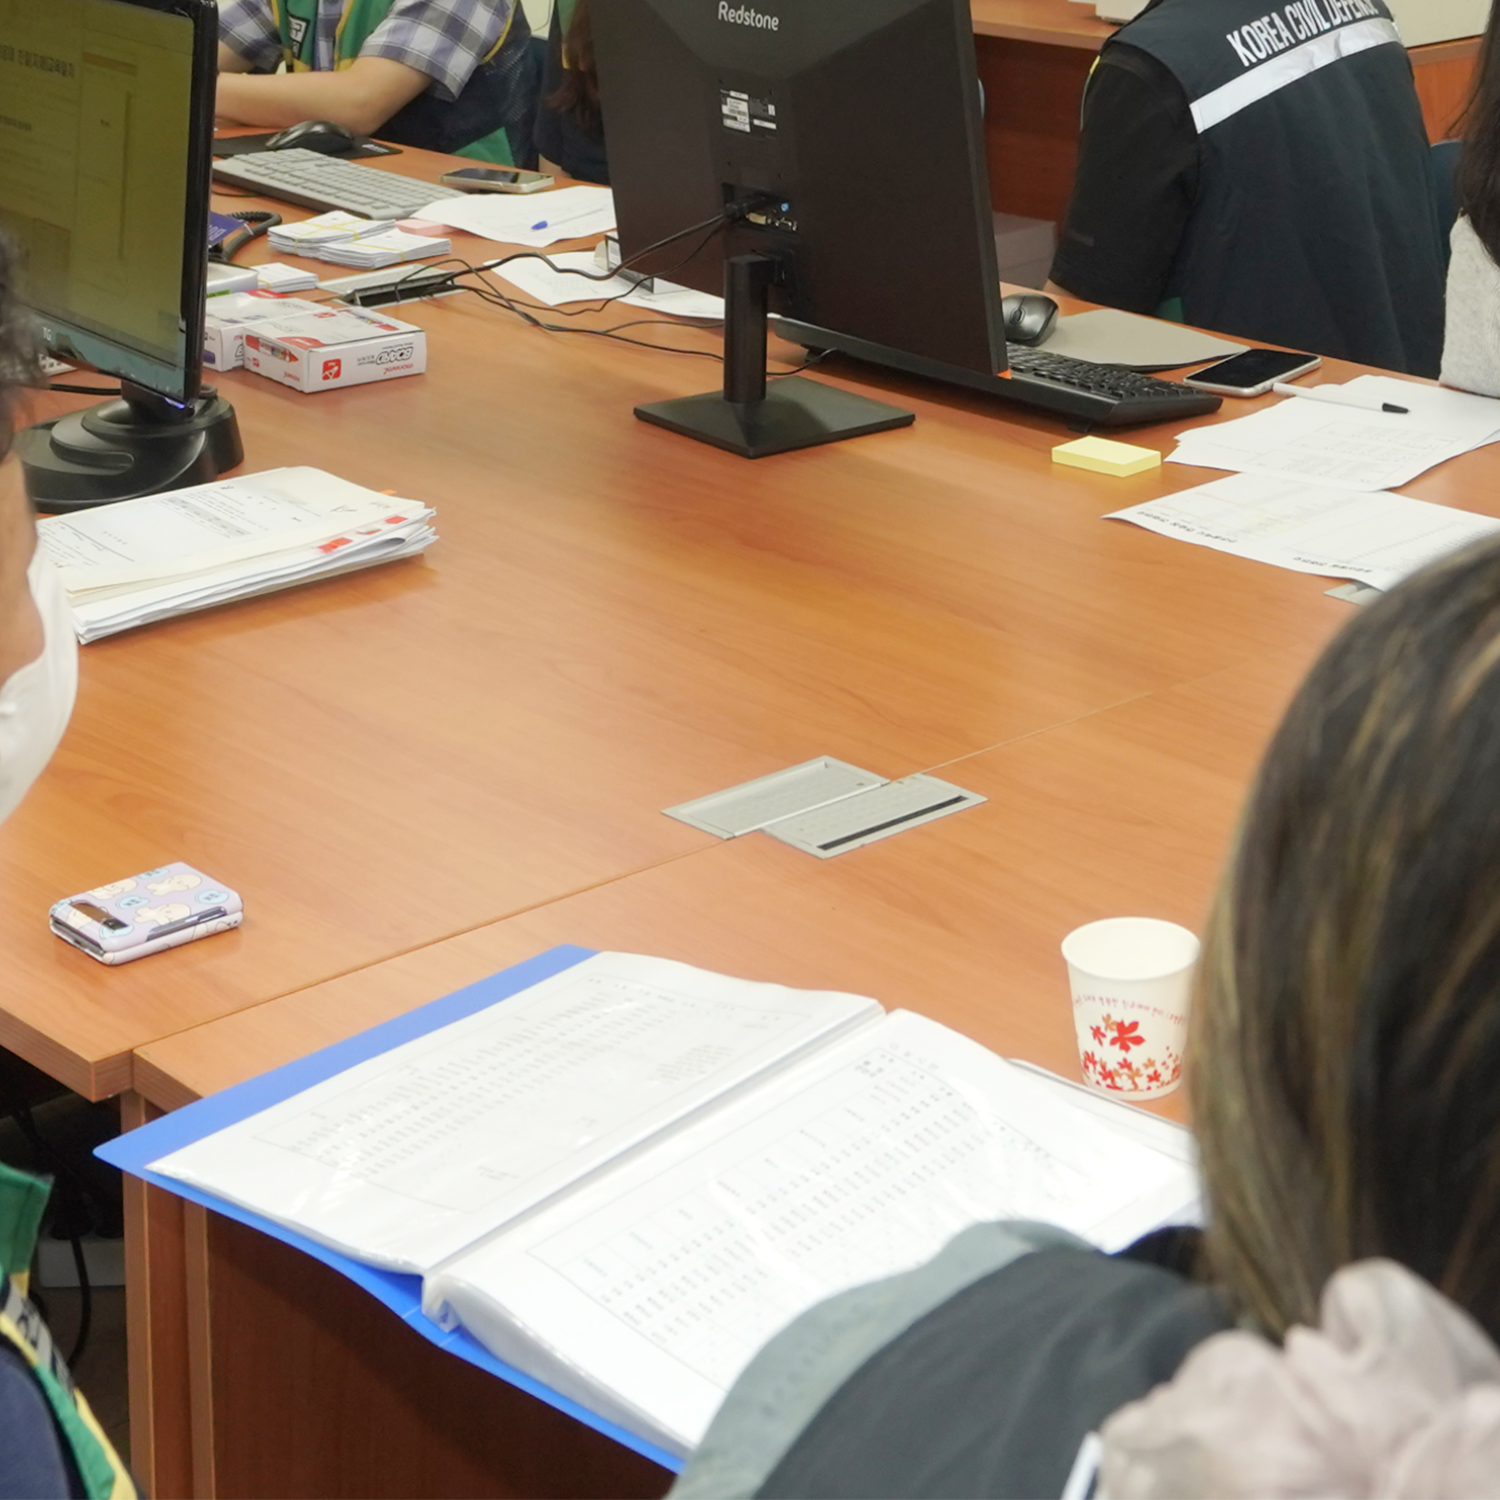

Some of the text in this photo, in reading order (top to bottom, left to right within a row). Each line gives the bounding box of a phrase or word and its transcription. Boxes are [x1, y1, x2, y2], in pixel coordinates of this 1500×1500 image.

[717, 0, 780, 32] Redstone
[1226, 11, 1296, 67] KOREA
[375, 346, 414, 366] BOARD
